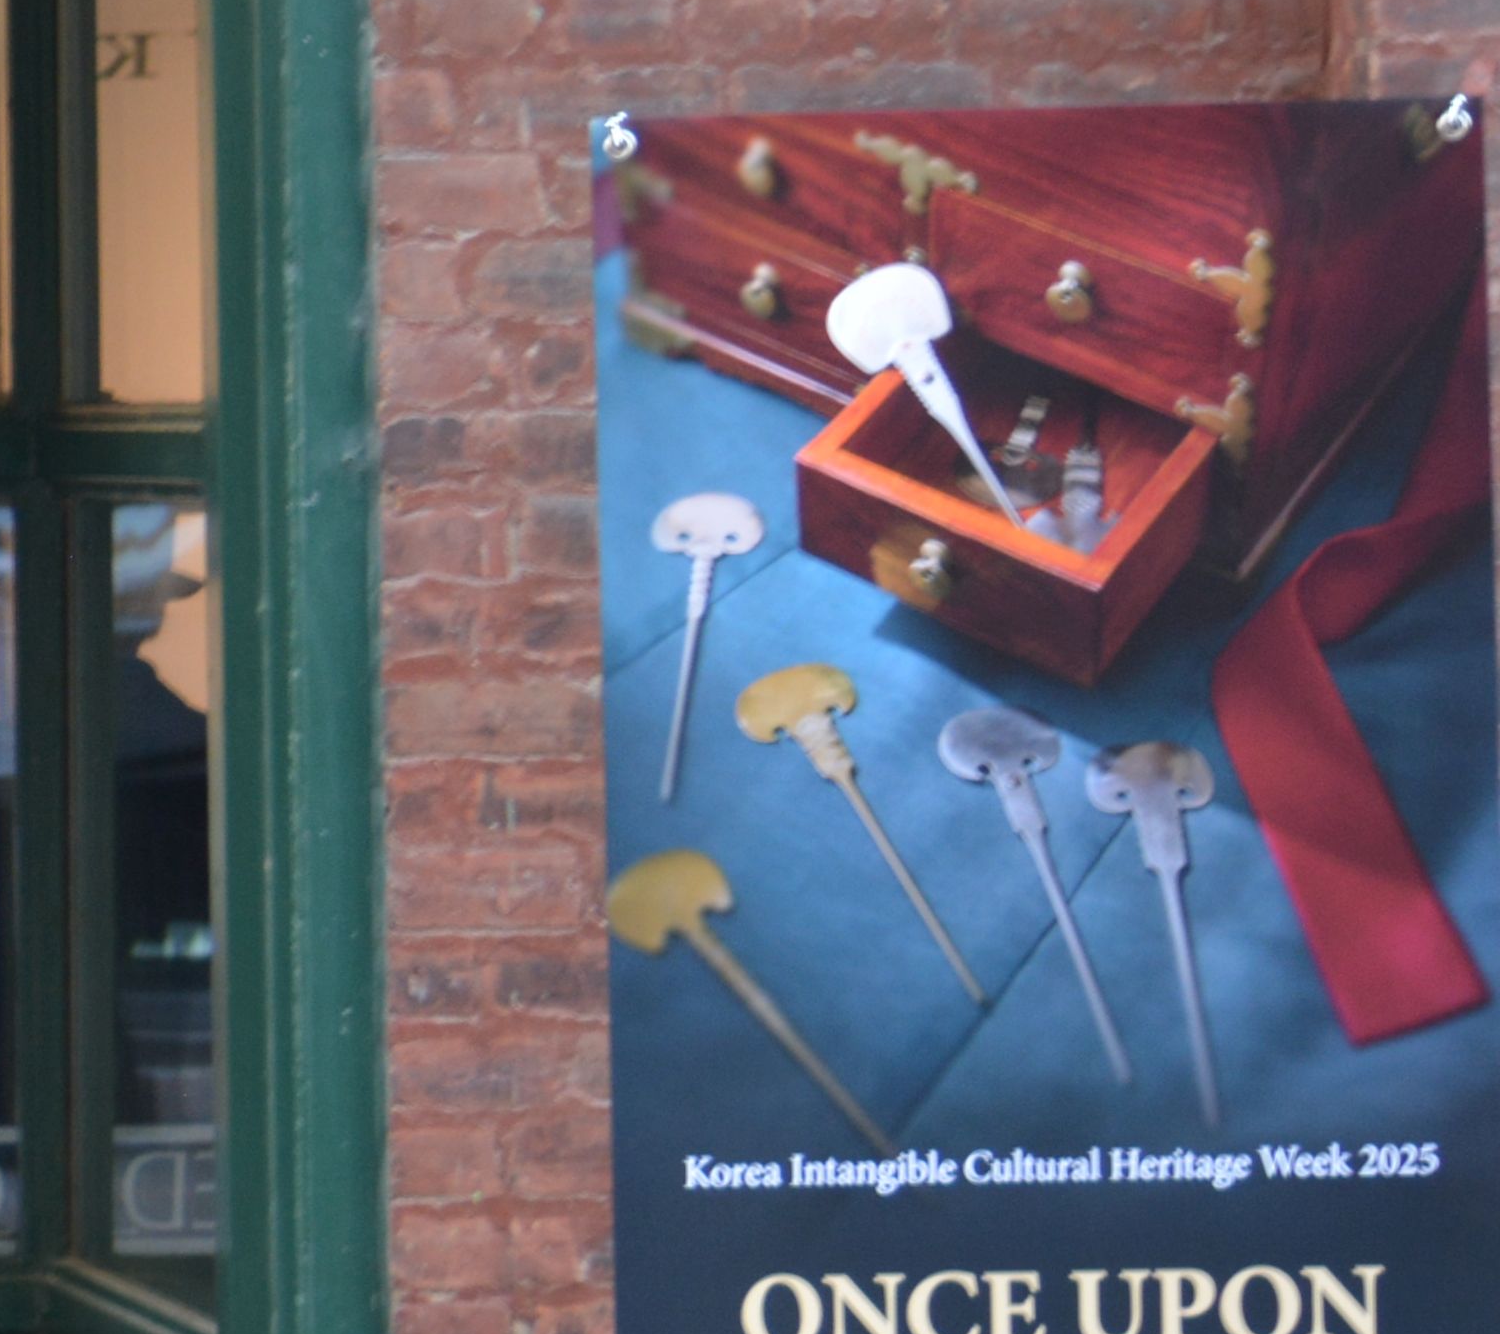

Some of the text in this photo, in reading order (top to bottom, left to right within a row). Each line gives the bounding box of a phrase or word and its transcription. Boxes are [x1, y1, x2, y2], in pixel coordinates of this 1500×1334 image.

[684, 1142, 1440, 1196] Korea Intangible Cultural Heritage Week 2025
